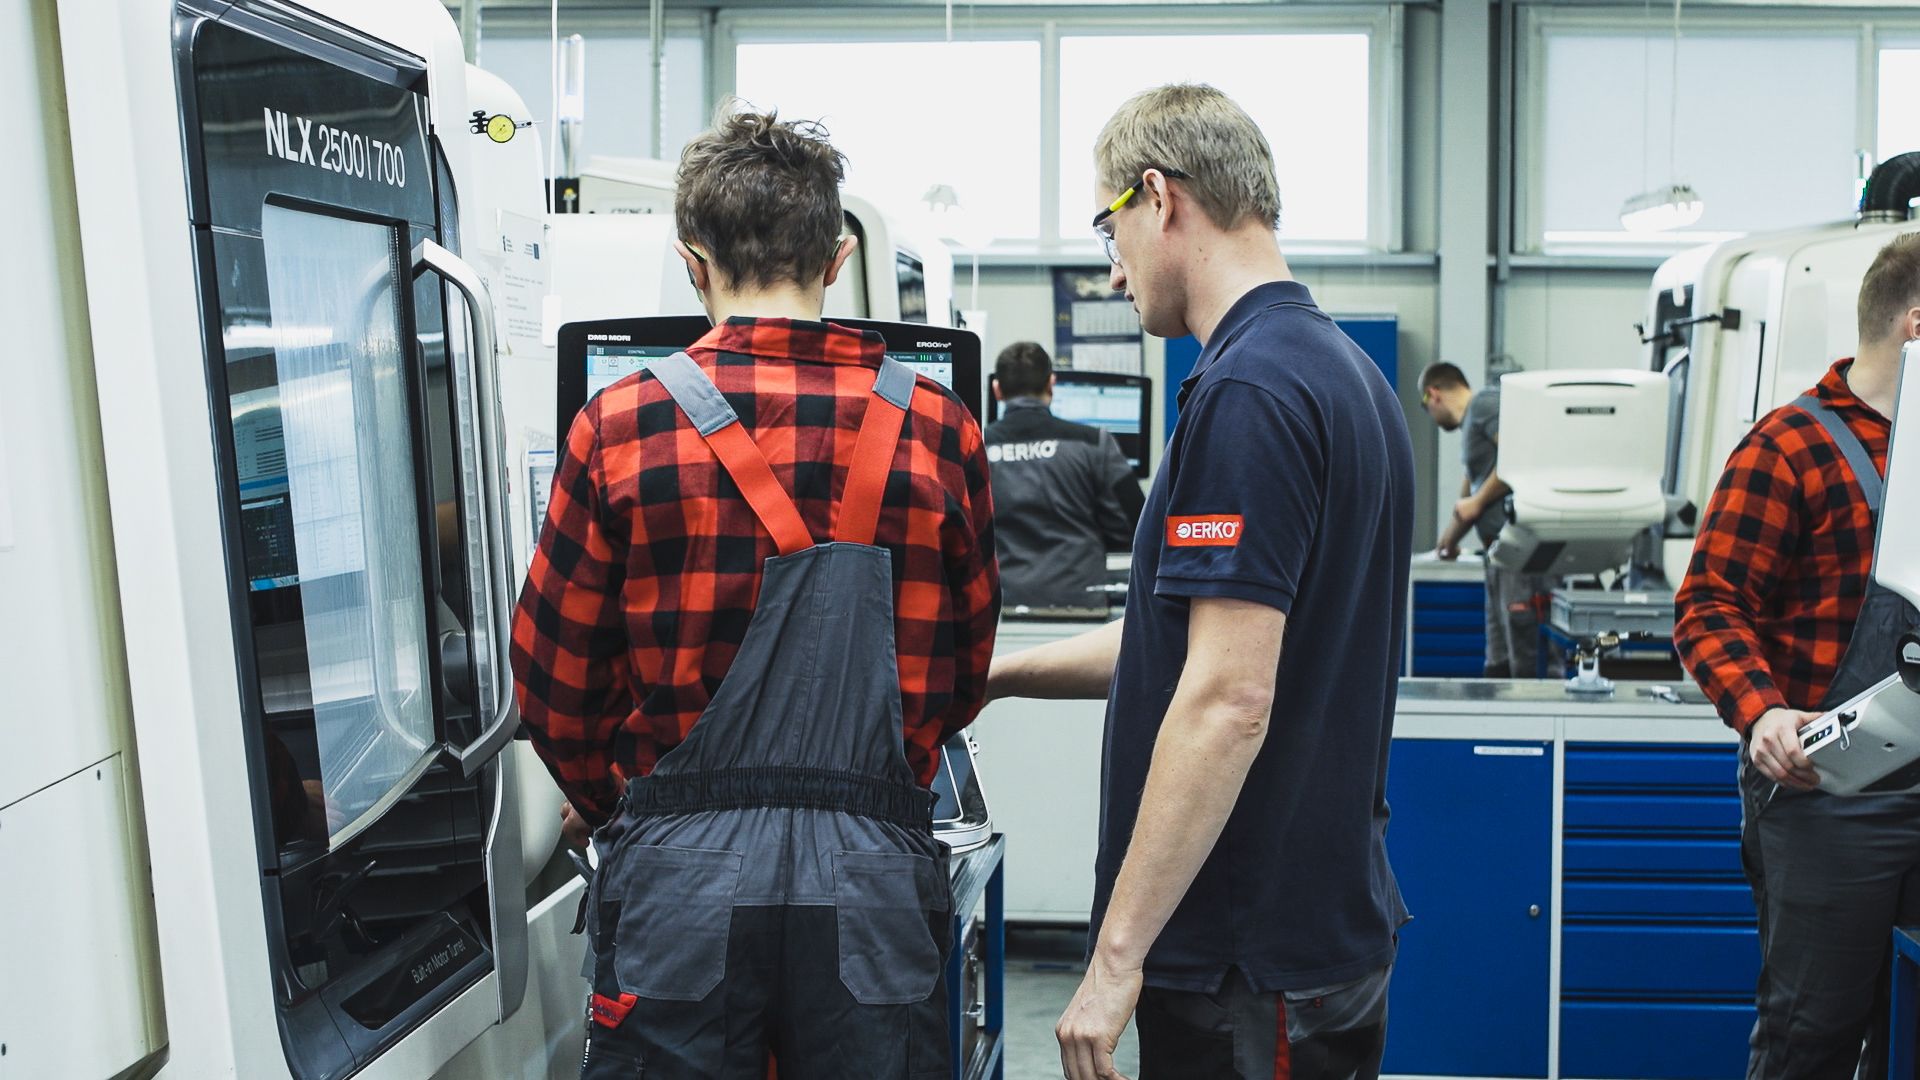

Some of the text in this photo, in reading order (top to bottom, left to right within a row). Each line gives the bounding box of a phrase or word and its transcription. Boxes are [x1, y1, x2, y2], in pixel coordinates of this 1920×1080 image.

[264, 107, 316, 167] NLX
[411, 961, 434, 984] Built-in
[430, 950, 449, 970] Motor
